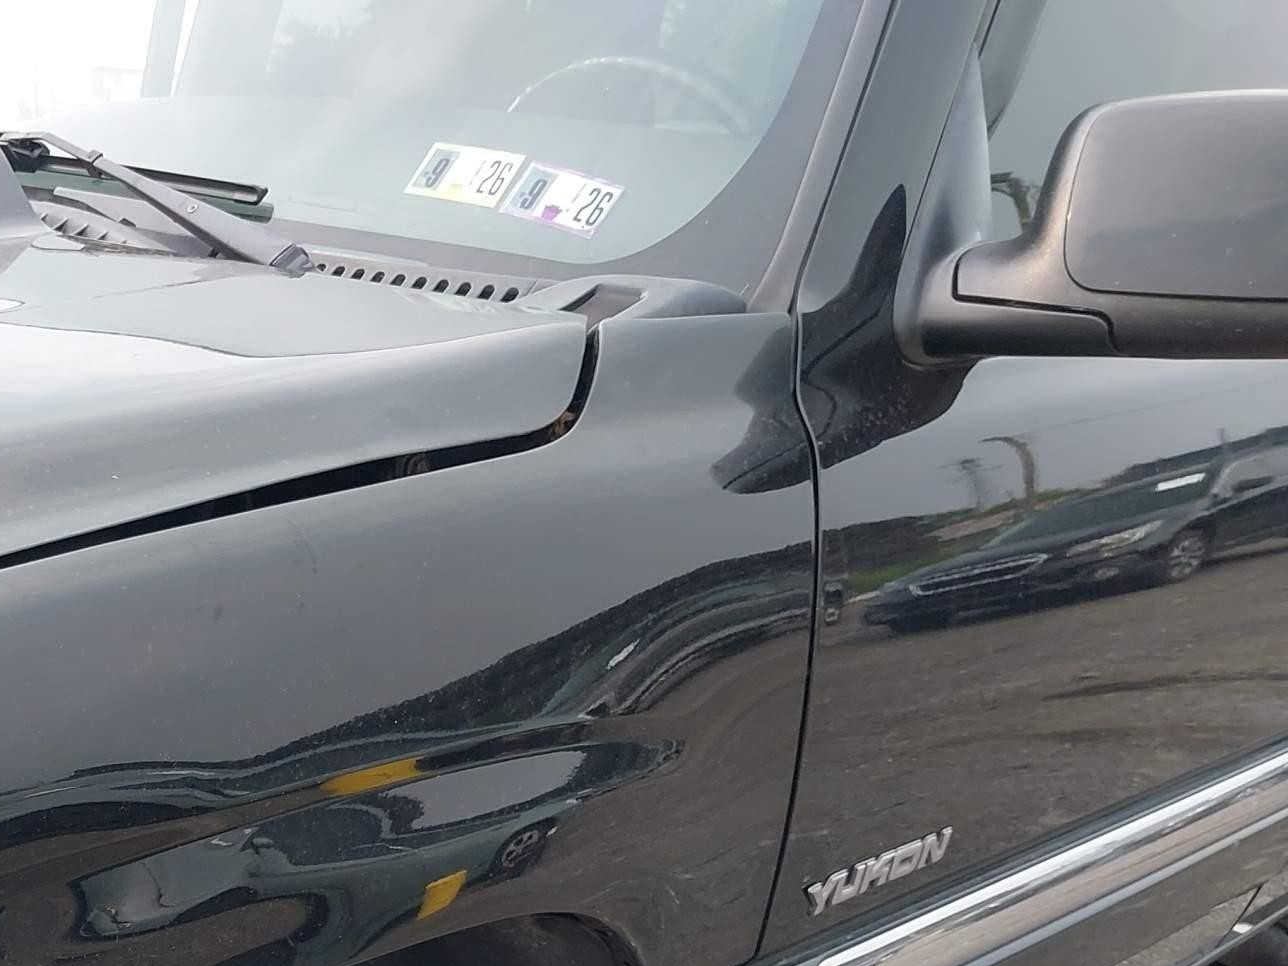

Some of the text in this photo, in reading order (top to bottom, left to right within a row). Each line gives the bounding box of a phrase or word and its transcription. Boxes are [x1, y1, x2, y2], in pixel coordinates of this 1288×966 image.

[476, 160, 514, 195] 26
[573, 187, 614, 226] 26
[805, 825, 953, 916] YUKON
